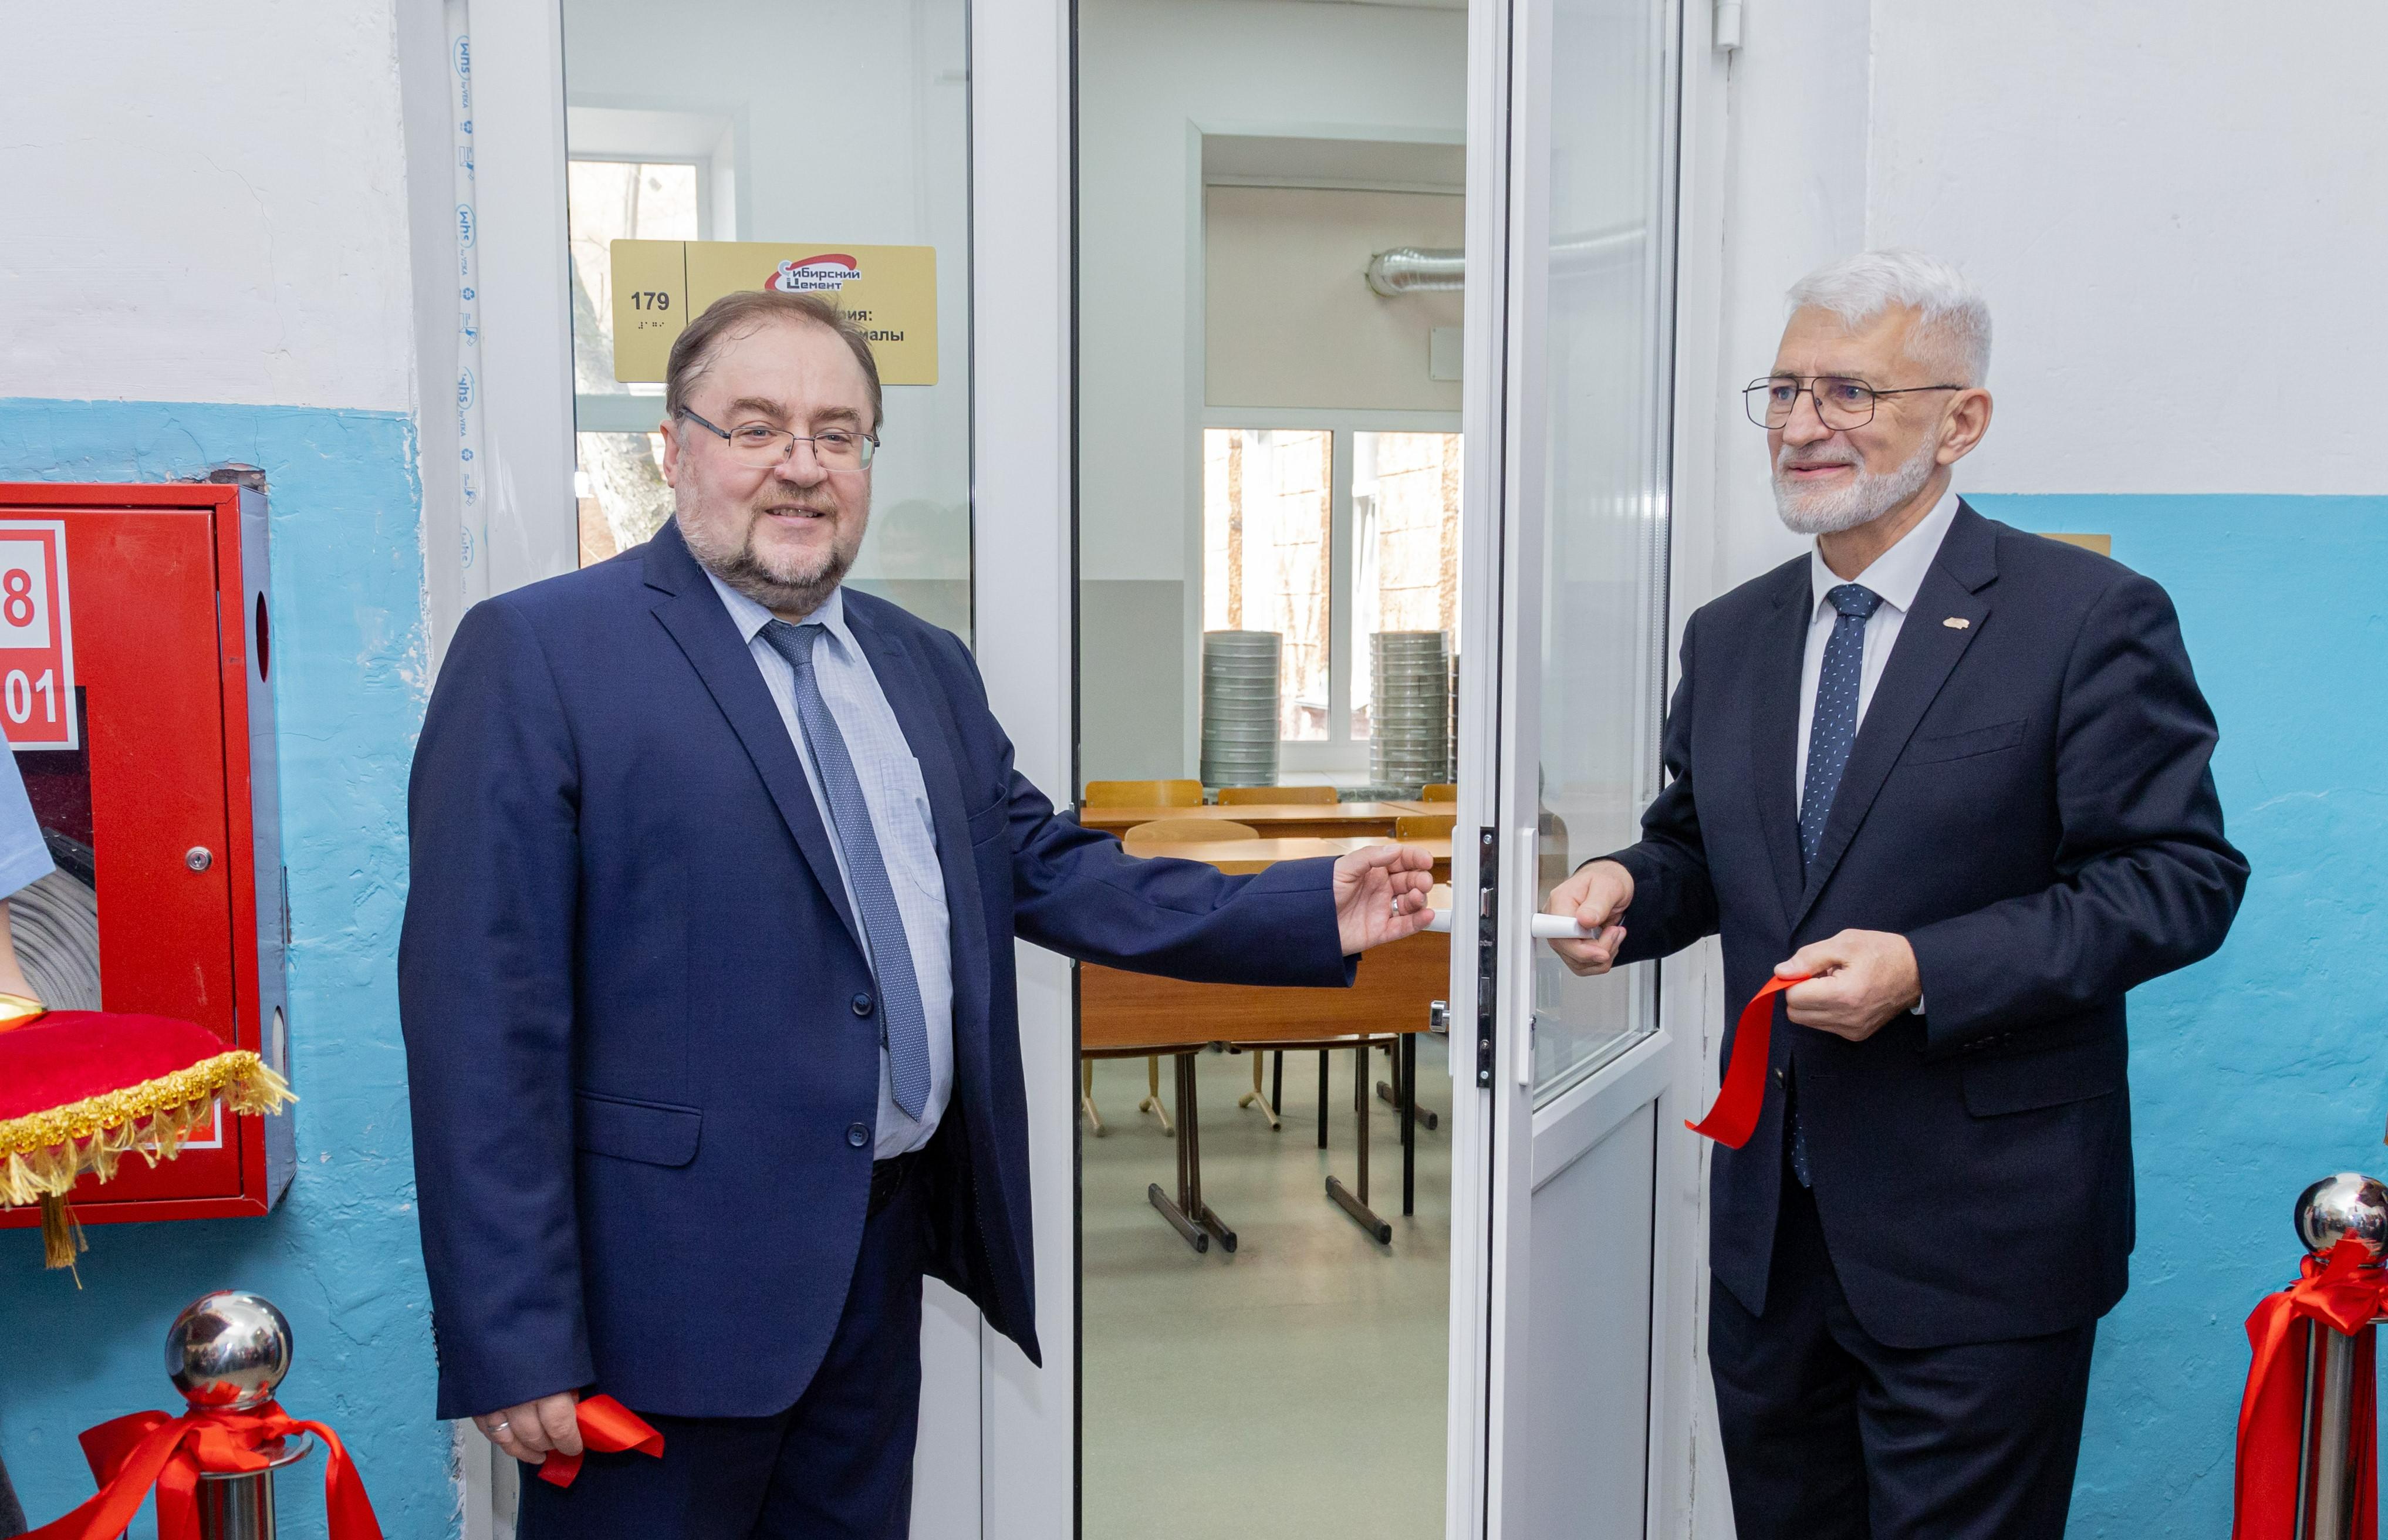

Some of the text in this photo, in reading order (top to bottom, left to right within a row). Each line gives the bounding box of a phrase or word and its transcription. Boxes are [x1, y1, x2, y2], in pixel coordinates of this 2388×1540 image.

[631, 291, 670, 310] 179
[786, 278, 842, 289] Цемент
[3, 568, 35, 627] 8
[5, 668, 56, 724] 01
